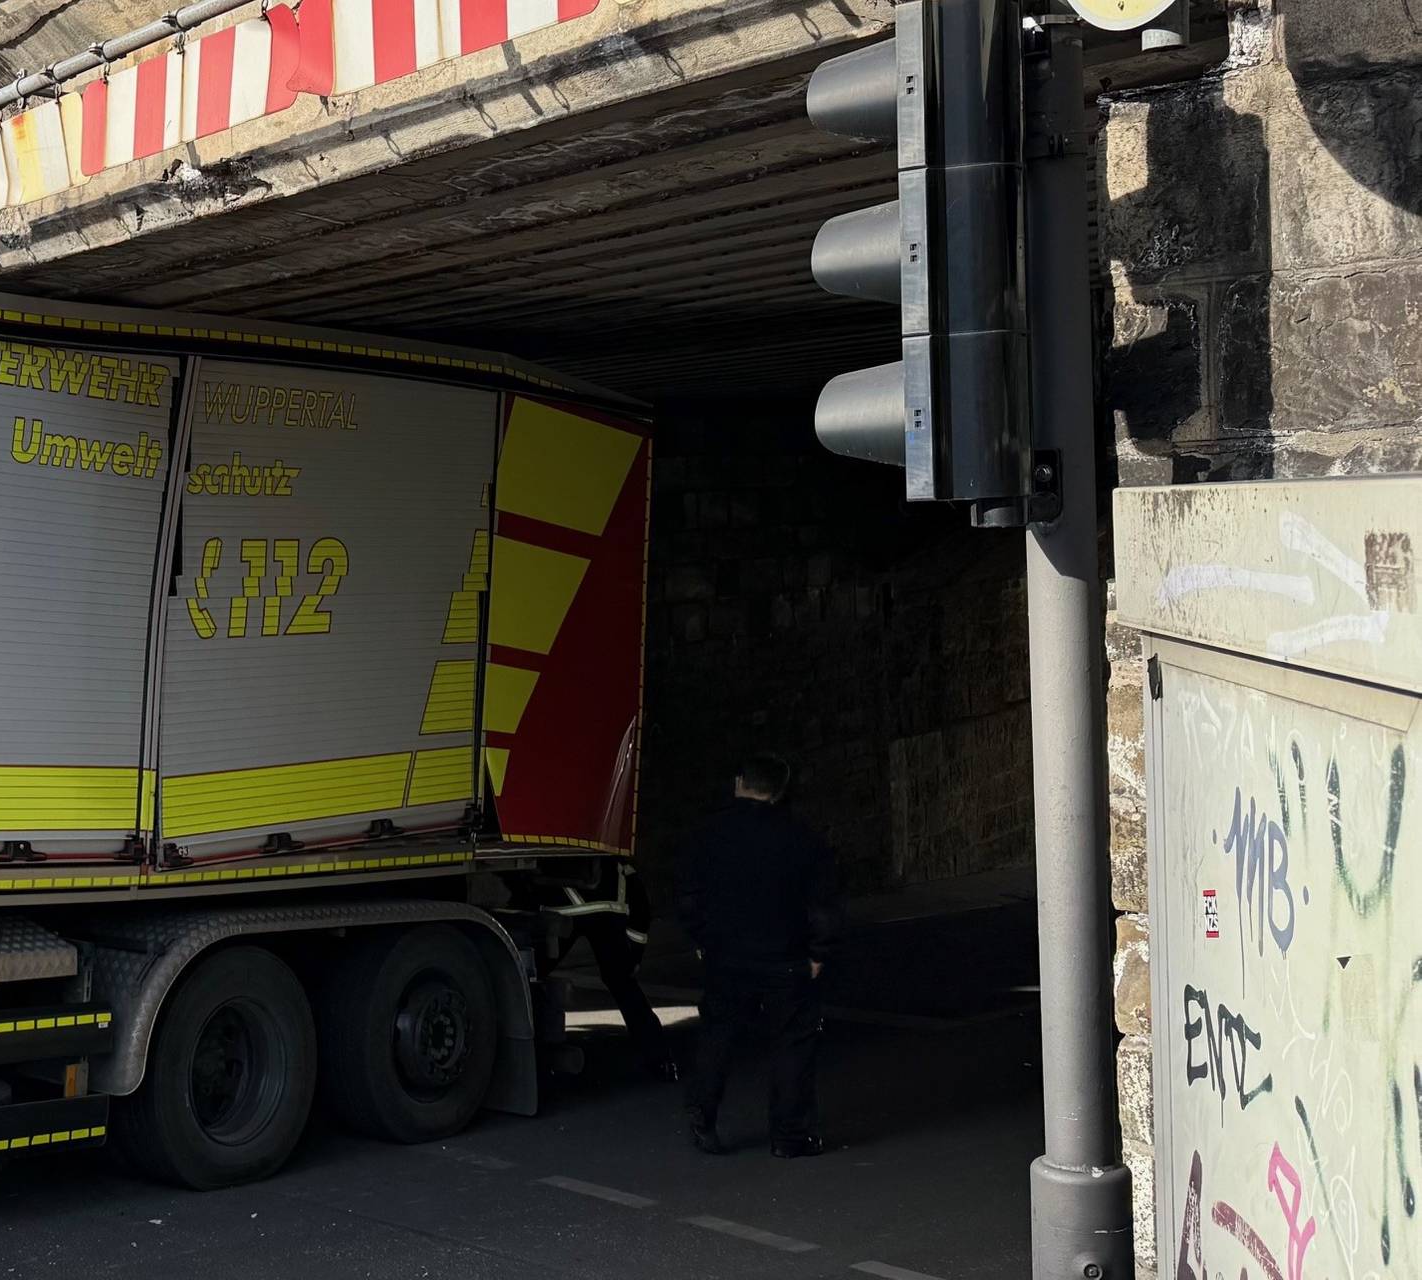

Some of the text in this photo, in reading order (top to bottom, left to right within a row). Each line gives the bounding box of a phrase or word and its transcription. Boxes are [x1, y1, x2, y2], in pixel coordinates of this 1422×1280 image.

[204, 380, 359, 431] WUPPERTAL
[11, 416, 302, 497] Umwelt schutz
[227, 537, 349, 638] 112
